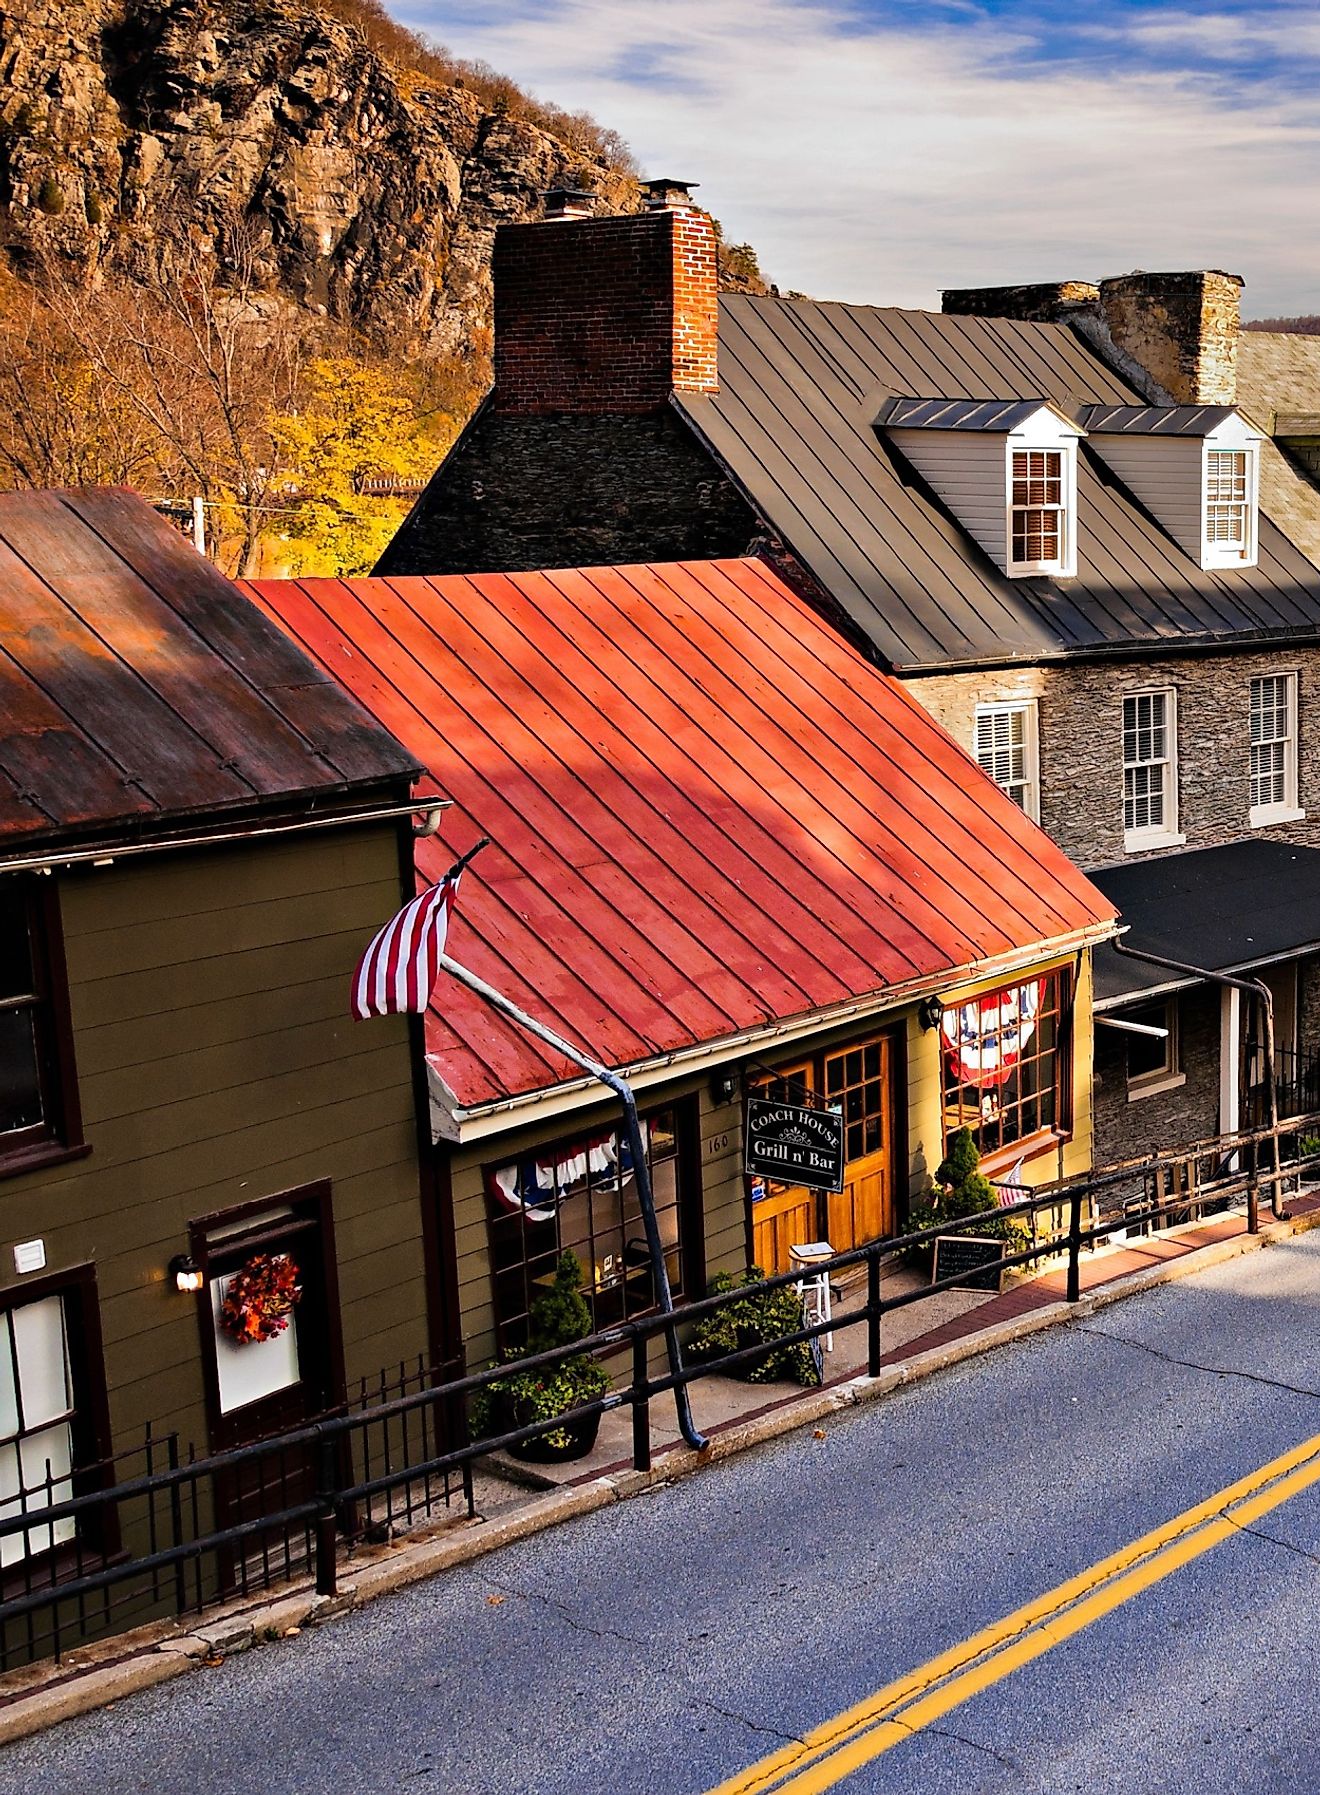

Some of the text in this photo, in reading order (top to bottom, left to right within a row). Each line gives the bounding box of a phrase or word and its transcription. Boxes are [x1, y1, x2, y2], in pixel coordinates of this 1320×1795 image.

[751, 1110, 839, 1148] COACH HOUSE
[708, 1135, 728, 1154] 160
[754, 1140, 788, 1160] Grill
[809, 1152, 835, 1169] Bar
